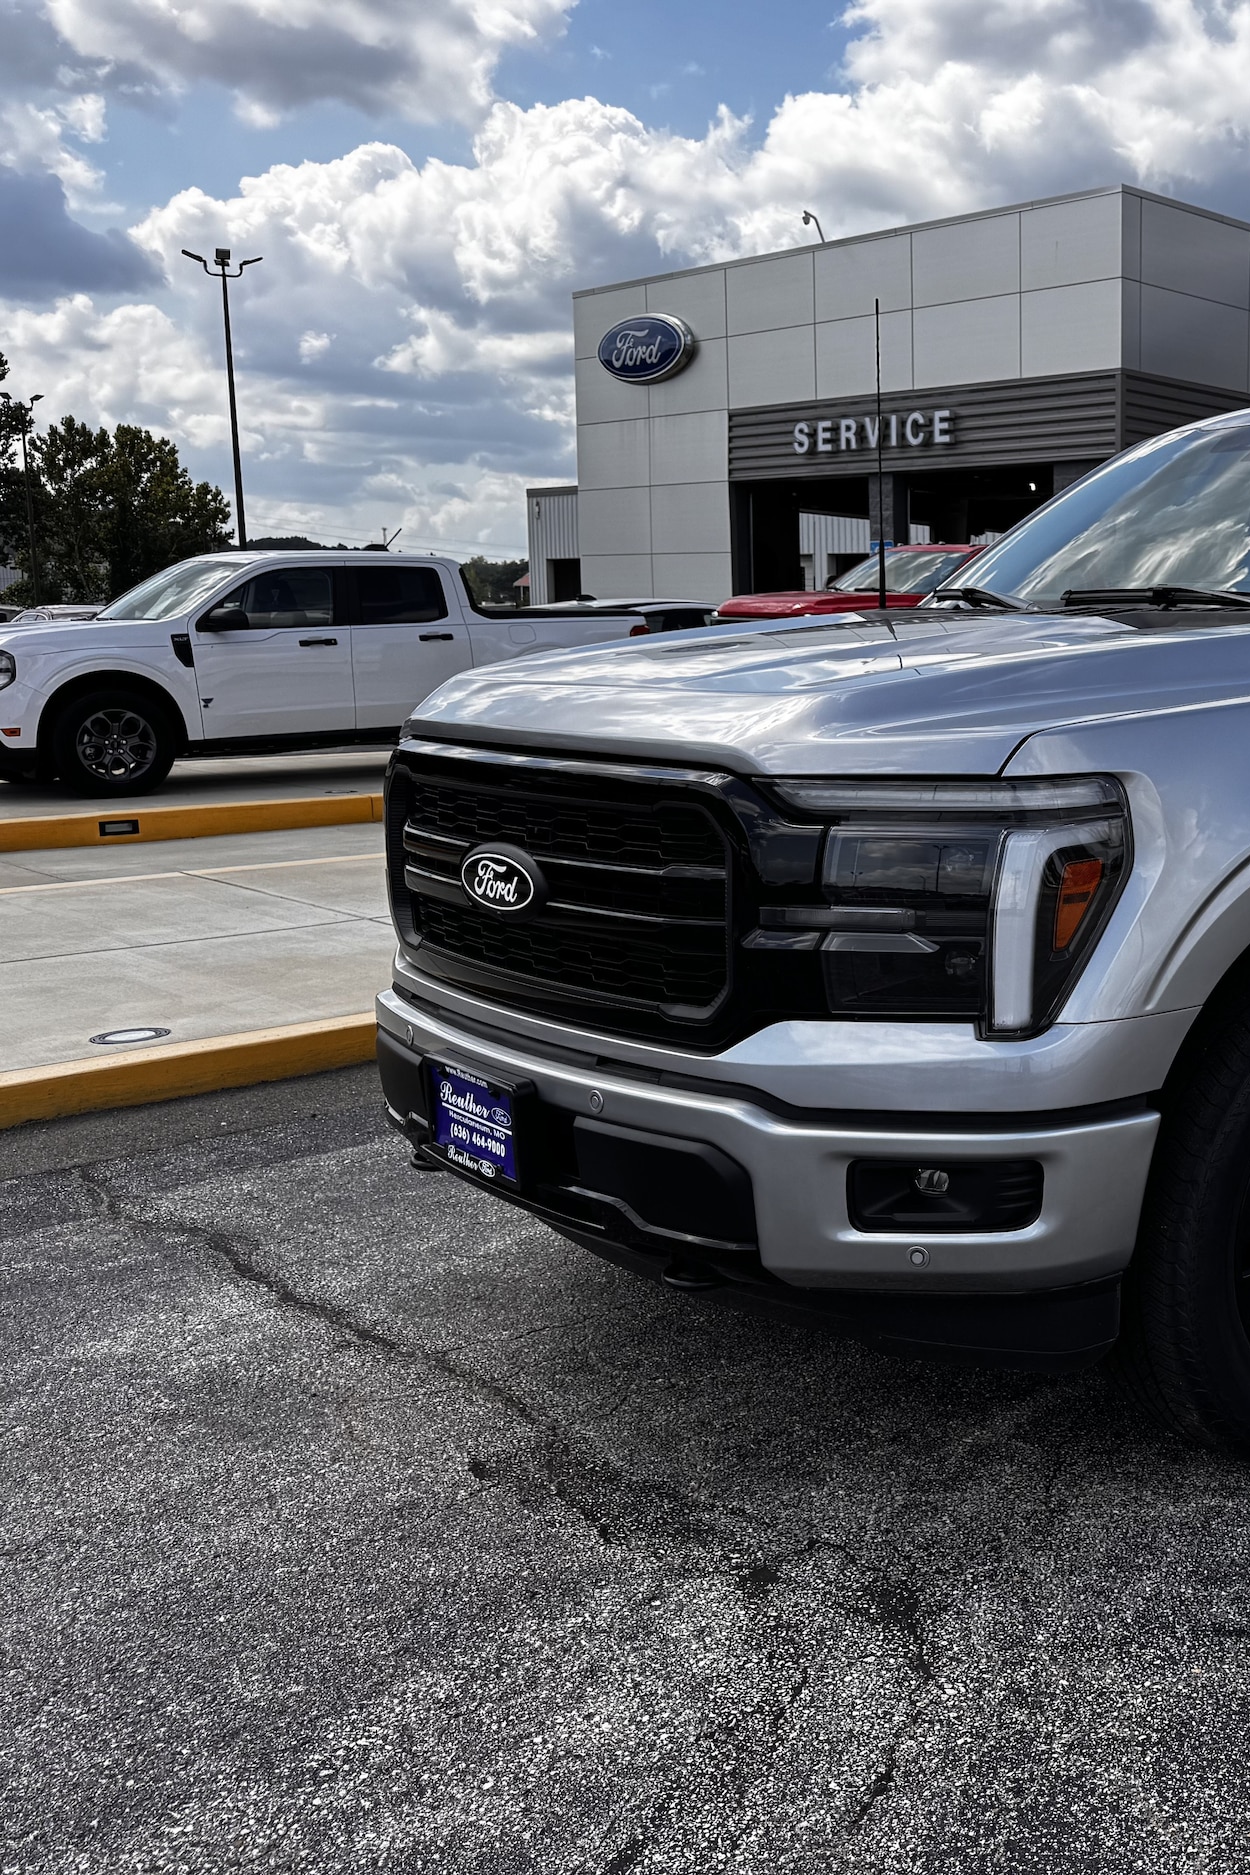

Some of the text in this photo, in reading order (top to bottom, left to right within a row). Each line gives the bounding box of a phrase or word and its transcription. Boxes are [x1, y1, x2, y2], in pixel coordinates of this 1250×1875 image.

[612, 329, 663, 369] Ford
[793, 410, 951, 454] SERVICE
[474, 860, 518, 903] Ford
[440, 1081, 490, 1119] Reuther
[450, 1122, 506, 1158] (636) 464-9000
[493, 1129, 506, 1140] MO
[447, 1144, 479, 1171] Reuther
